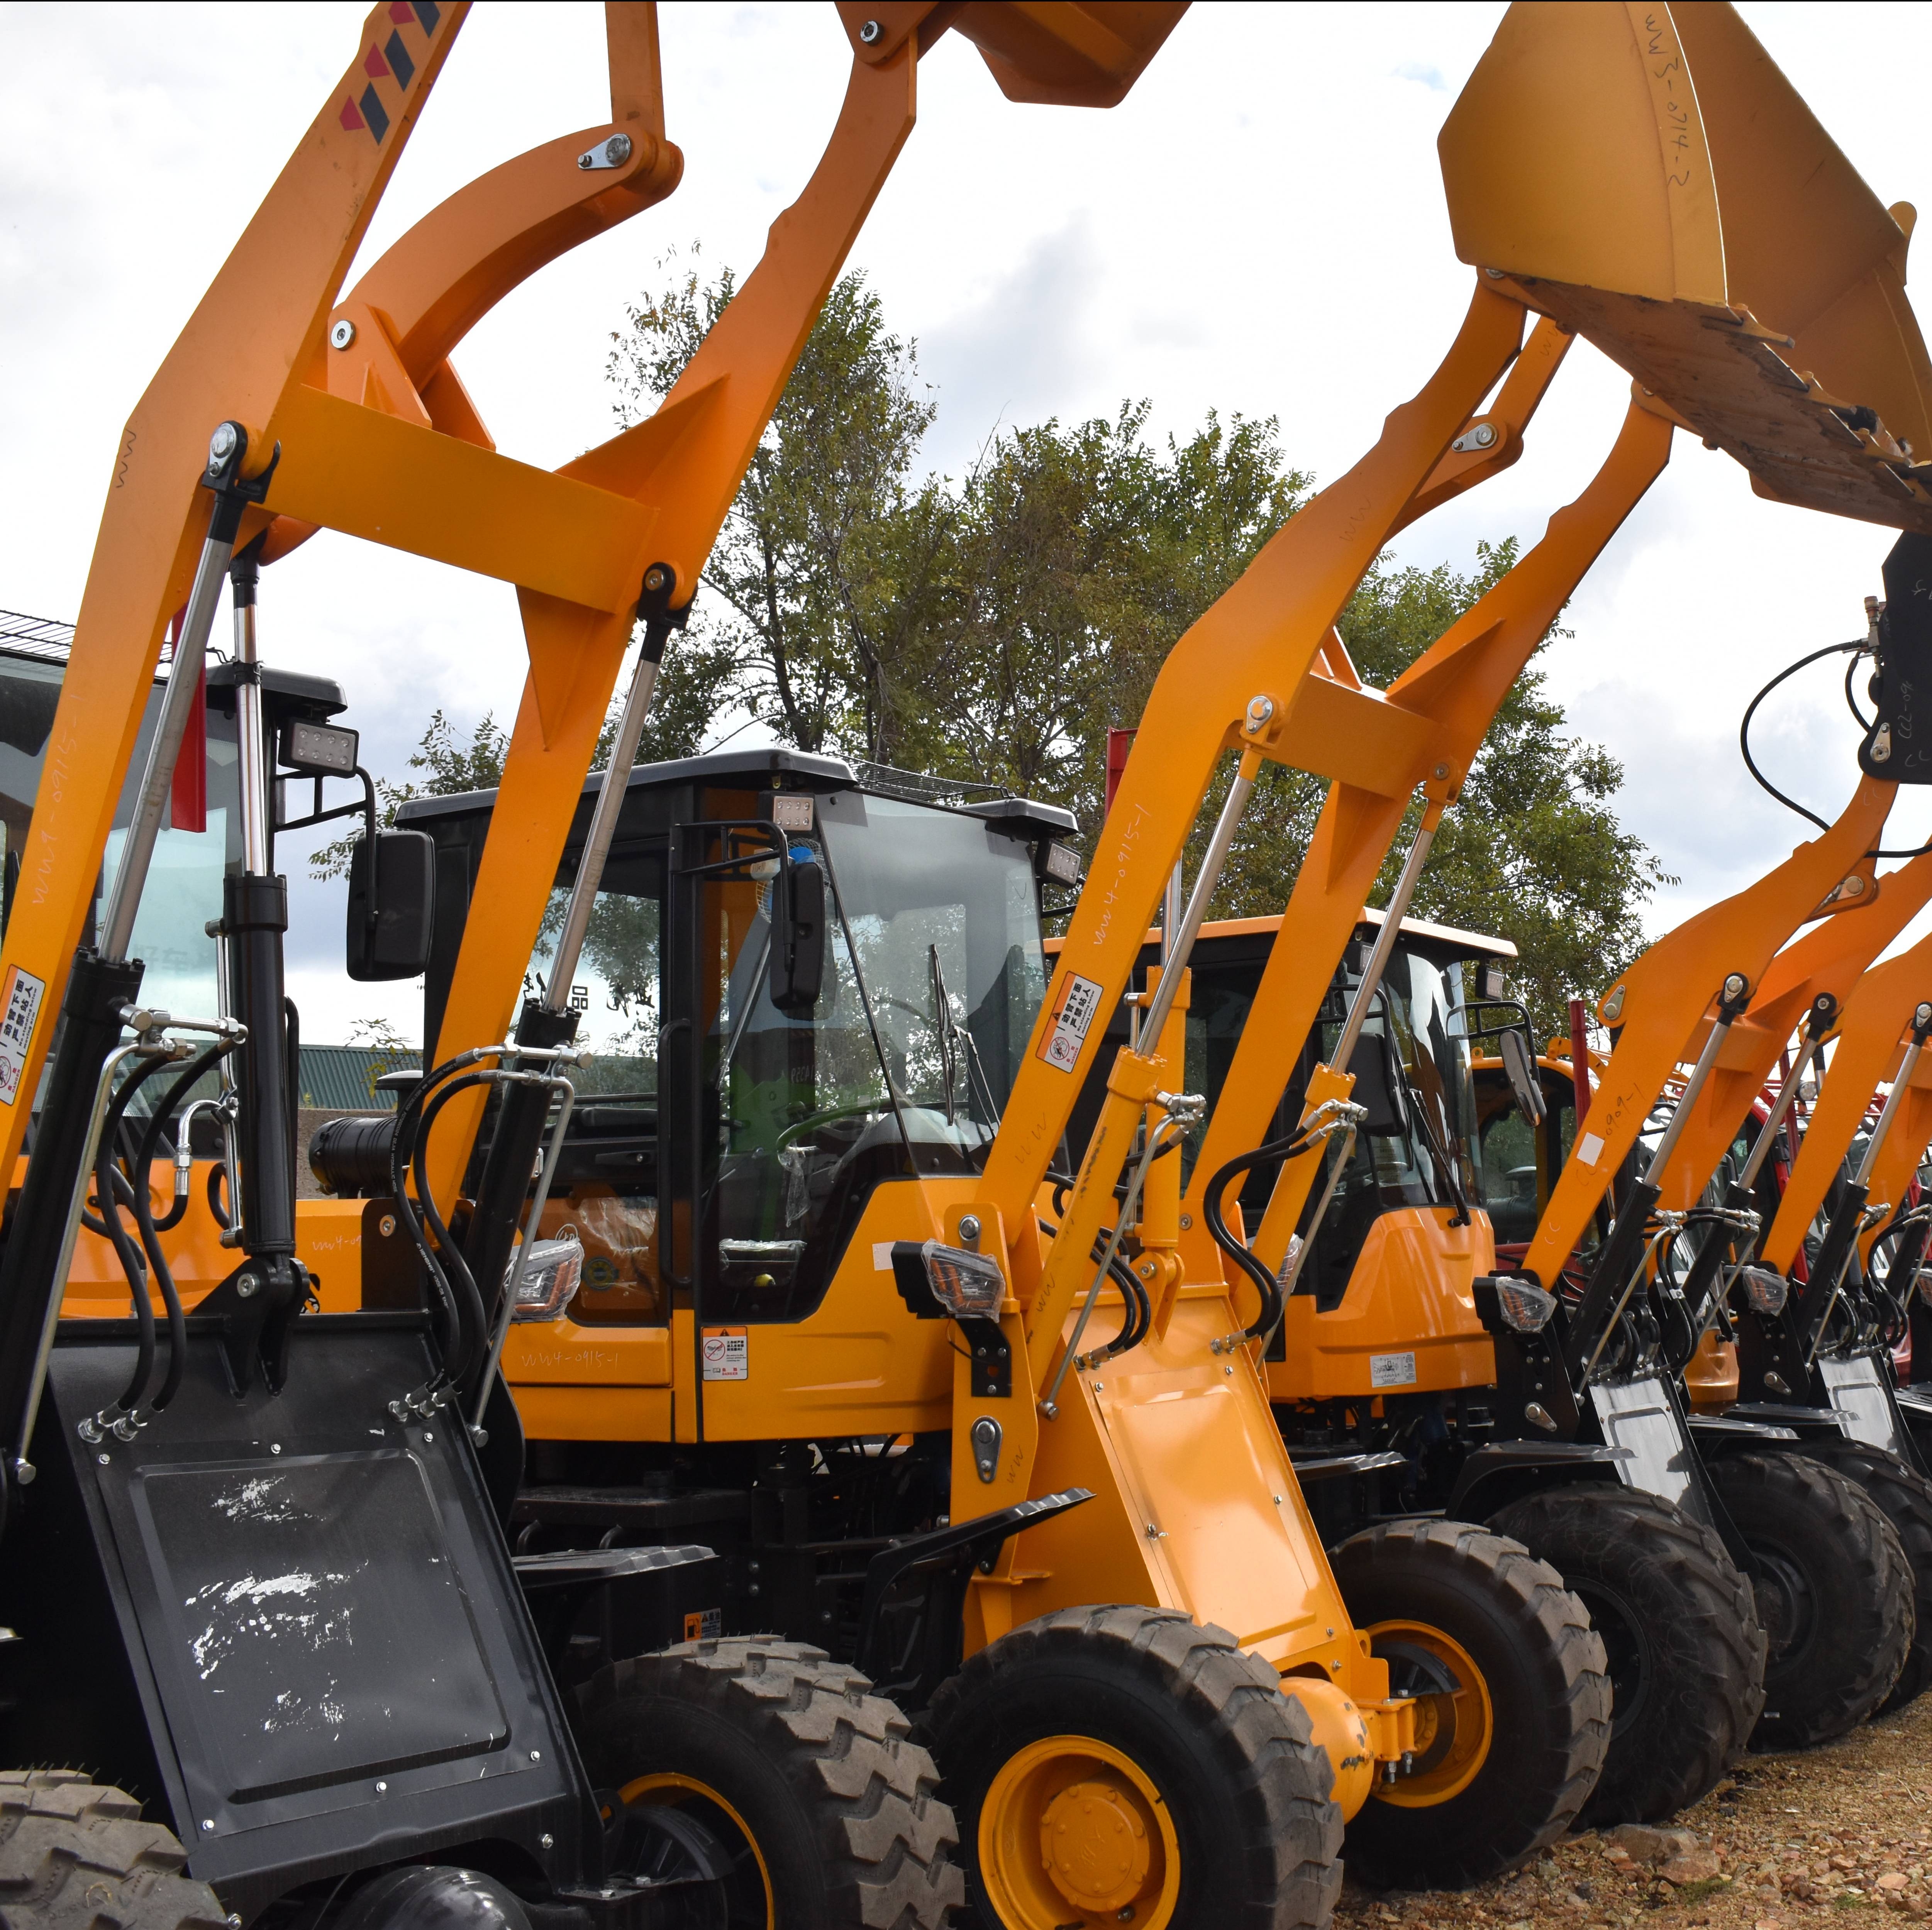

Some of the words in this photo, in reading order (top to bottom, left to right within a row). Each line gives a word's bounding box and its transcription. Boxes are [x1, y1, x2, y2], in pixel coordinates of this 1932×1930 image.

[12, 986, 33, 1042] 严禁站人
[1062, 982, 1082, 1023] 动臂下面
[1070, 989, 1091, 1028] 严禁站人
[1080, 1005, 1090, 1025] standing
[24, 1026, 32, 1049] moving
[1081, 1018, 1090, 1034] moving
